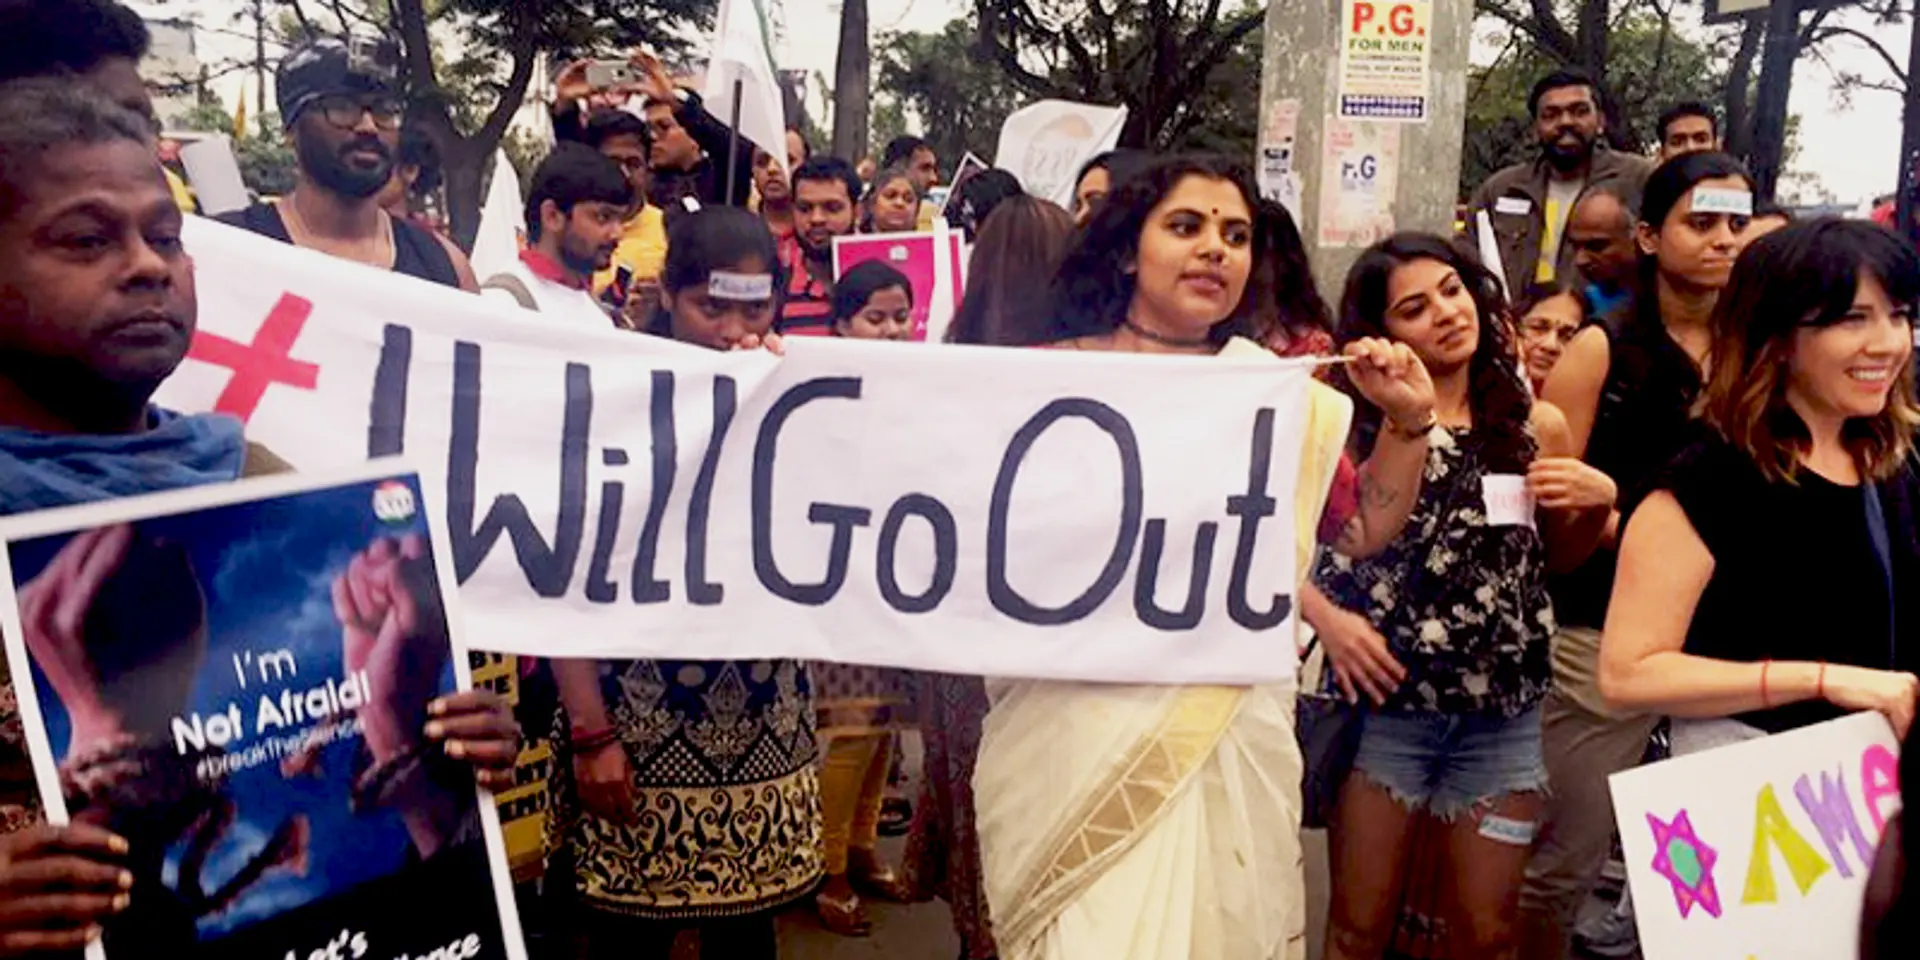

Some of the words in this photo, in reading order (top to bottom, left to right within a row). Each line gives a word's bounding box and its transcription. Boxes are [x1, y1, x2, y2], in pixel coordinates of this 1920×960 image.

[1352, 2, 1425, 36] P.G.
[1348, 39, 1382, 51] FOR
[1387, 39, 1423, 52] MEN
[232, 648, 297, 690] I'm
[170, 701, 243, 756] Not
